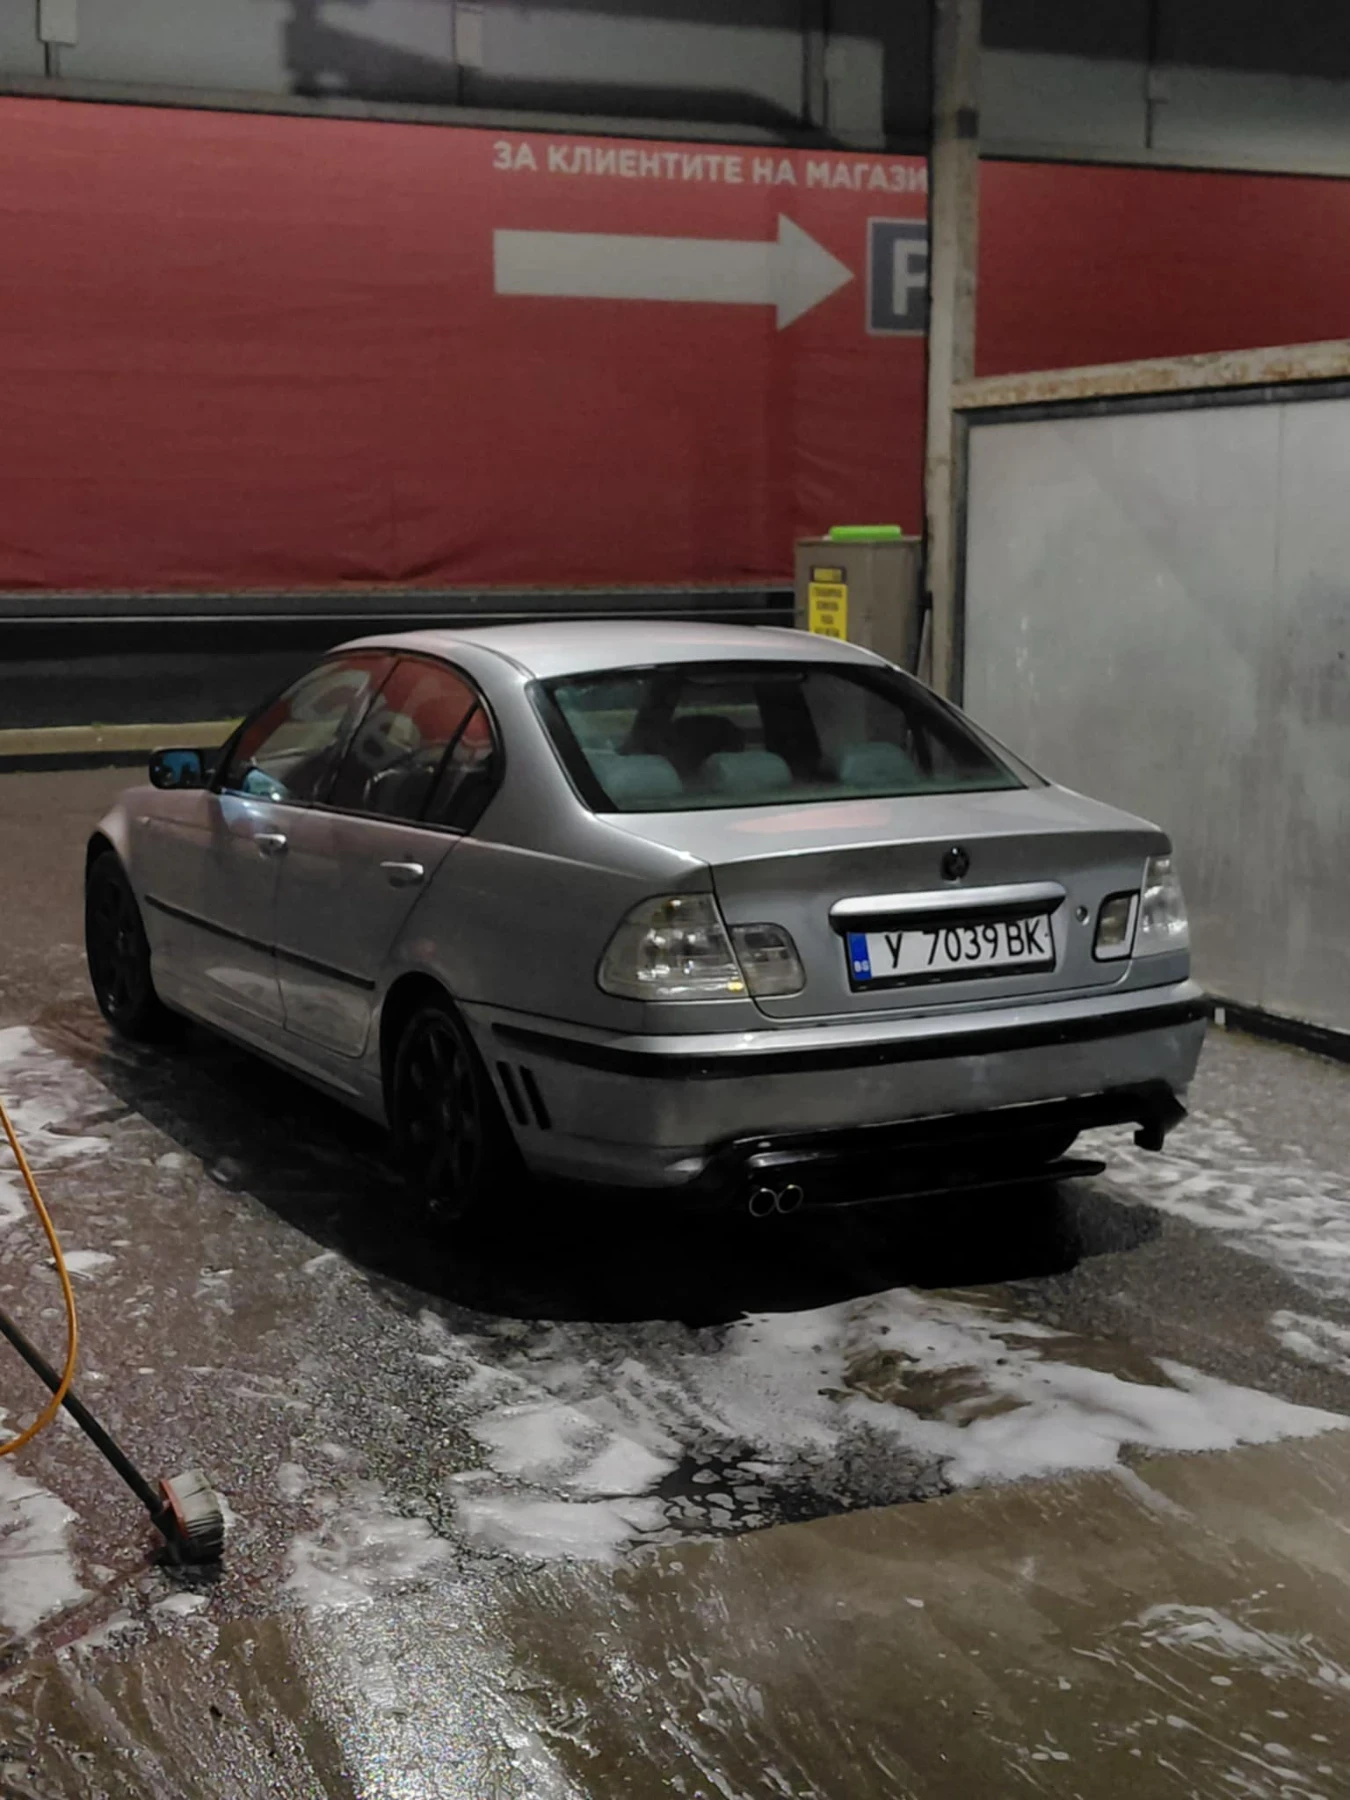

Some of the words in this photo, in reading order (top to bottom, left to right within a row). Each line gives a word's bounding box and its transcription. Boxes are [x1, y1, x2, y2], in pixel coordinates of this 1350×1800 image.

[493, 141, 538, 171] ЗА
[547, 145, 743, 184] КЛИЕНТИТЕ
[752, 157, 797, 186] НА
